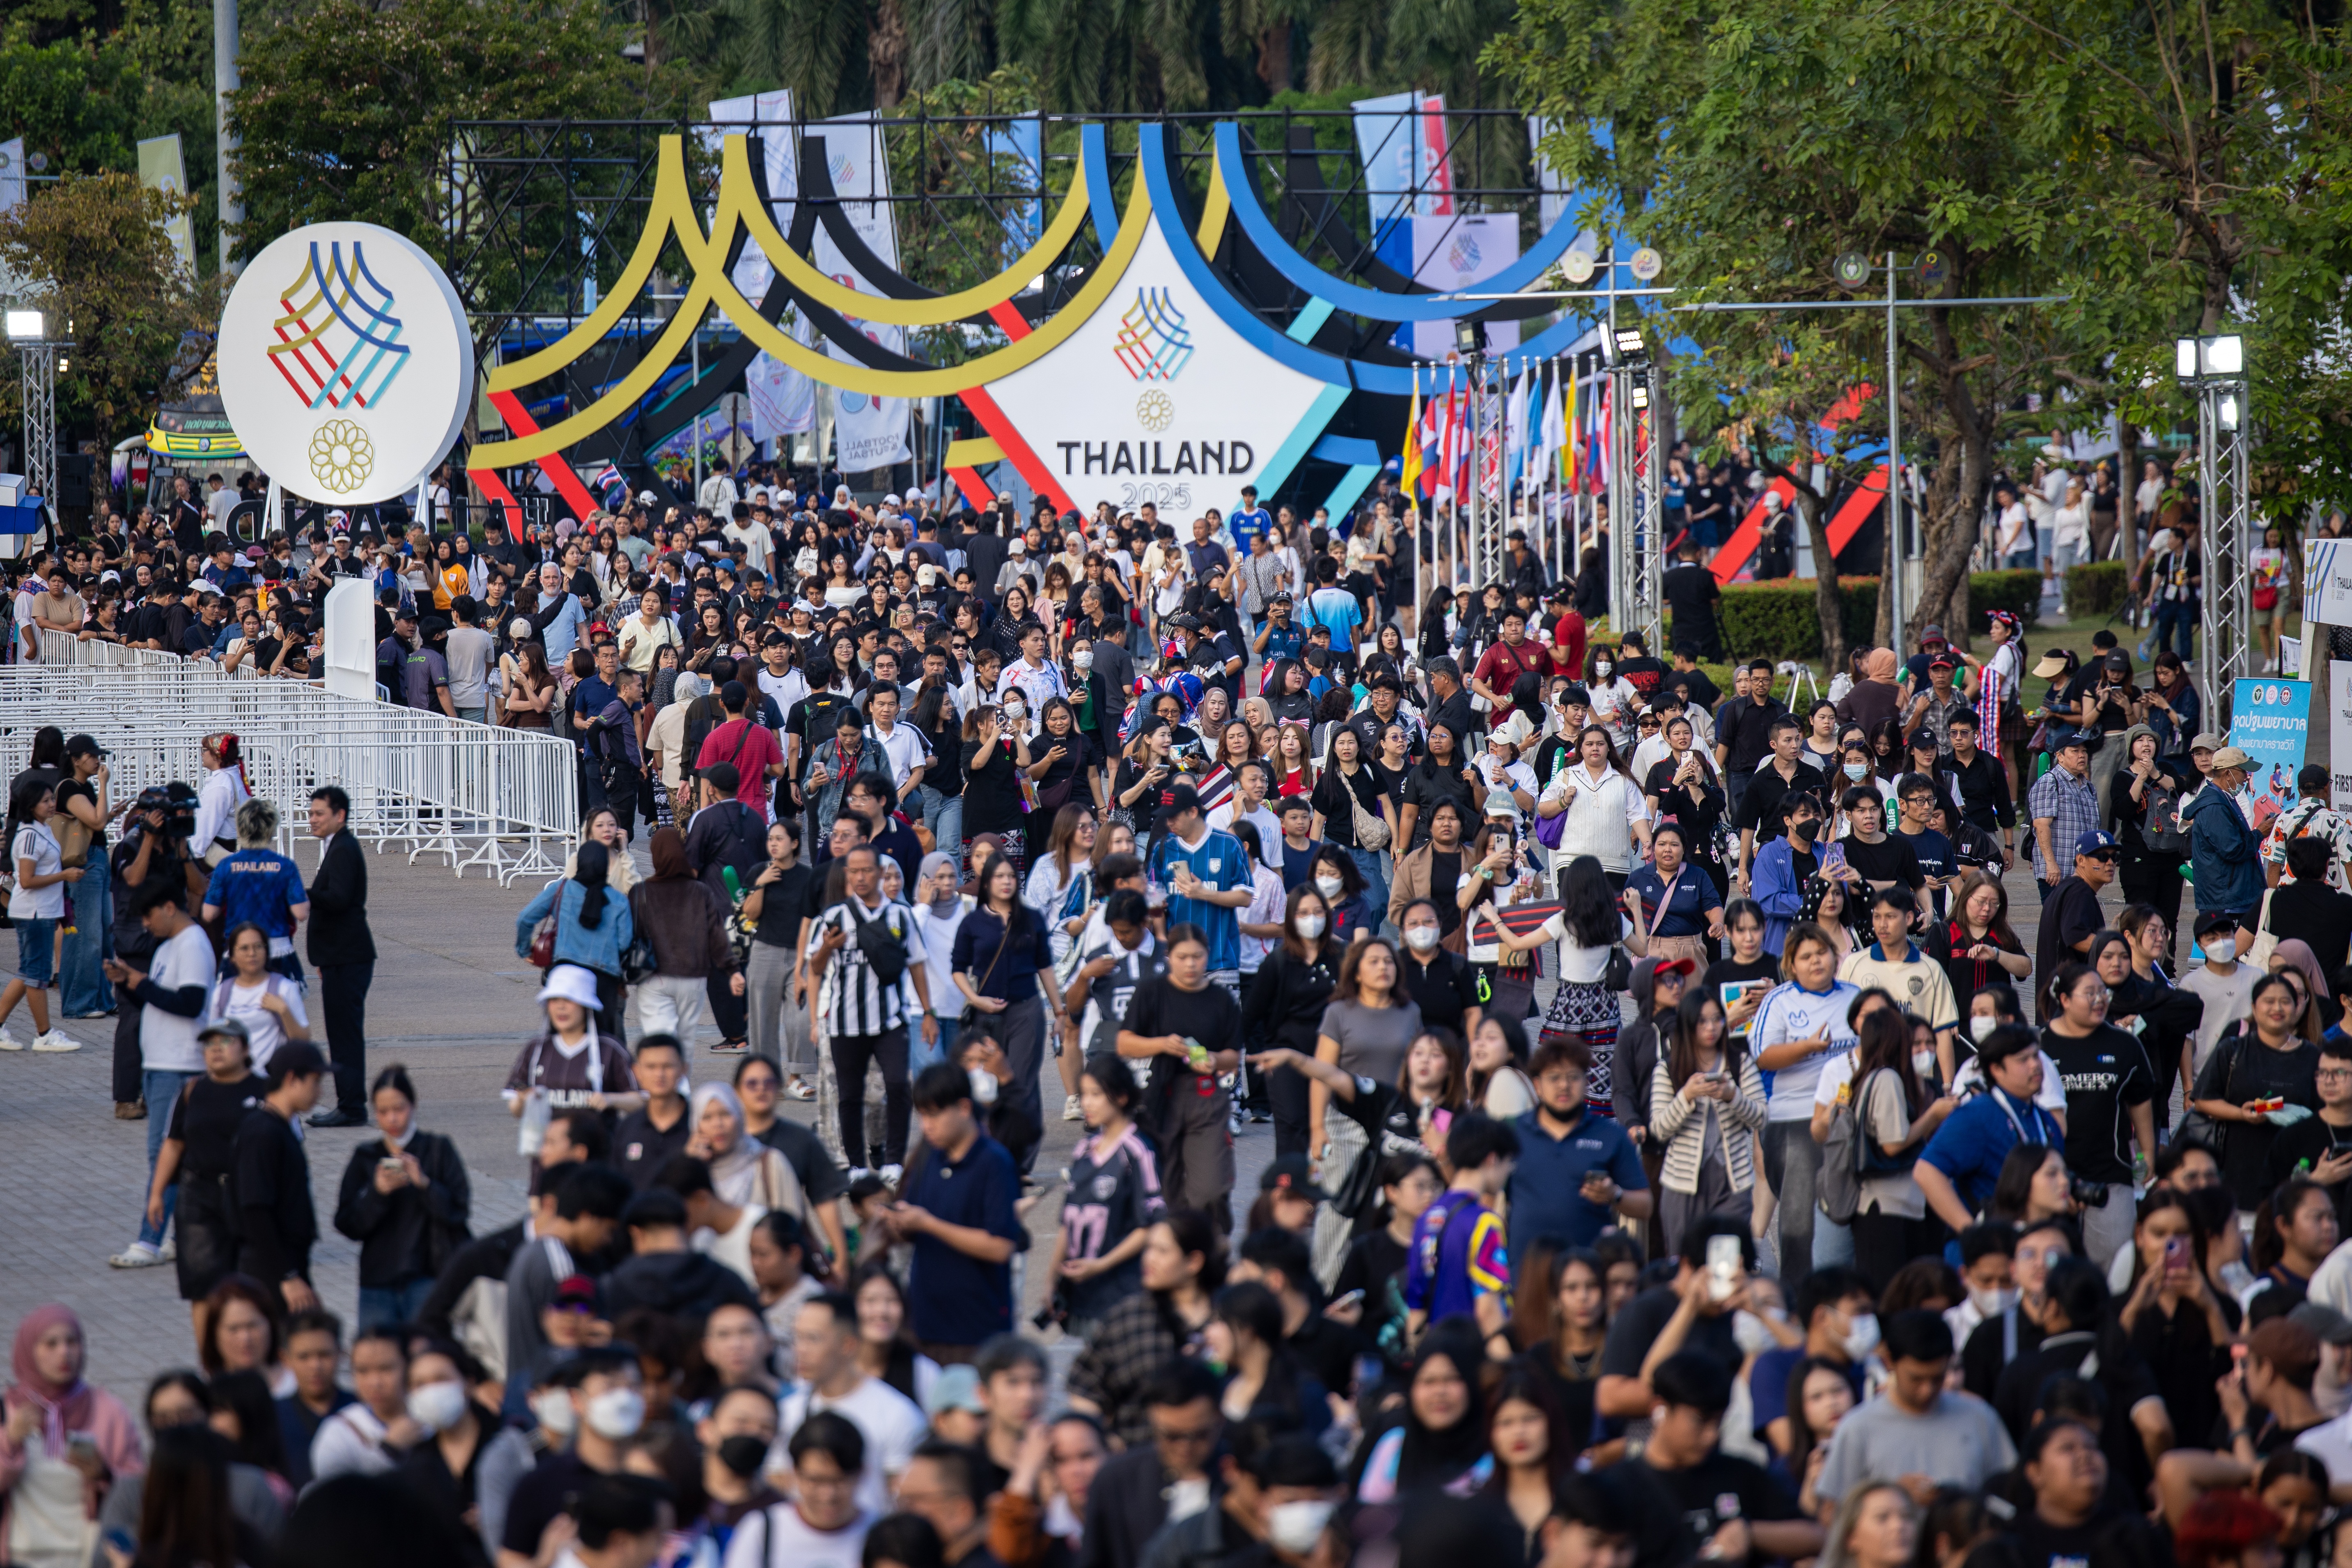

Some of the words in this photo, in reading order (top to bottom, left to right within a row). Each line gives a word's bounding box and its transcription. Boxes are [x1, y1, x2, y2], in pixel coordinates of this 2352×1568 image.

[1057, 441, 1255, 475] THAILAND
[1121, 482, 1192, 510] 2025
[2233, 711, 2306, 733] จุดปฐมพยาบาล
[2237, 736, 2295, 751] โรงพยาบาลราชวิถี
[2097, 832, 2108, 845] LA
[231, 861, 281, 873] THAILAND
[2060, 1072, 2118, 1085] OMEBOY
